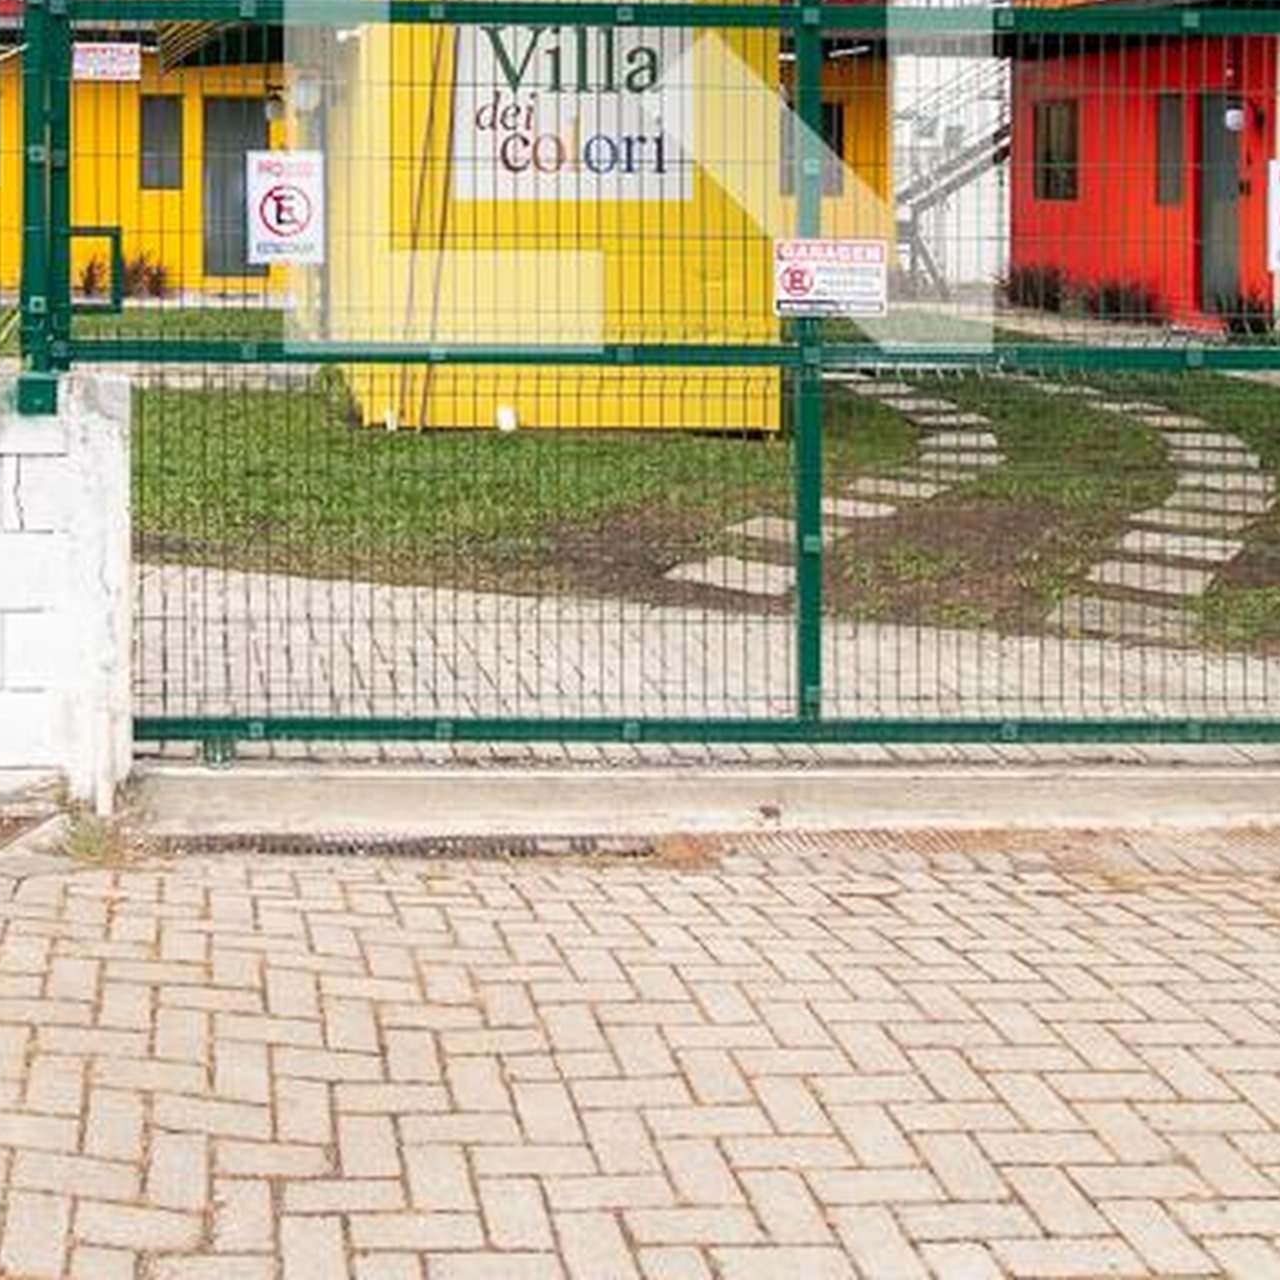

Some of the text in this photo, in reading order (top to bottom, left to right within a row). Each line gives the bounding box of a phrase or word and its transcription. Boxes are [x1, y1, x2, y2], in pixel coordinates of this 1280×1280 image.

[480, 24, 664, 94] Villa
[476, 90, 538, 131] dei
[499, 115, 668, 174] colori
